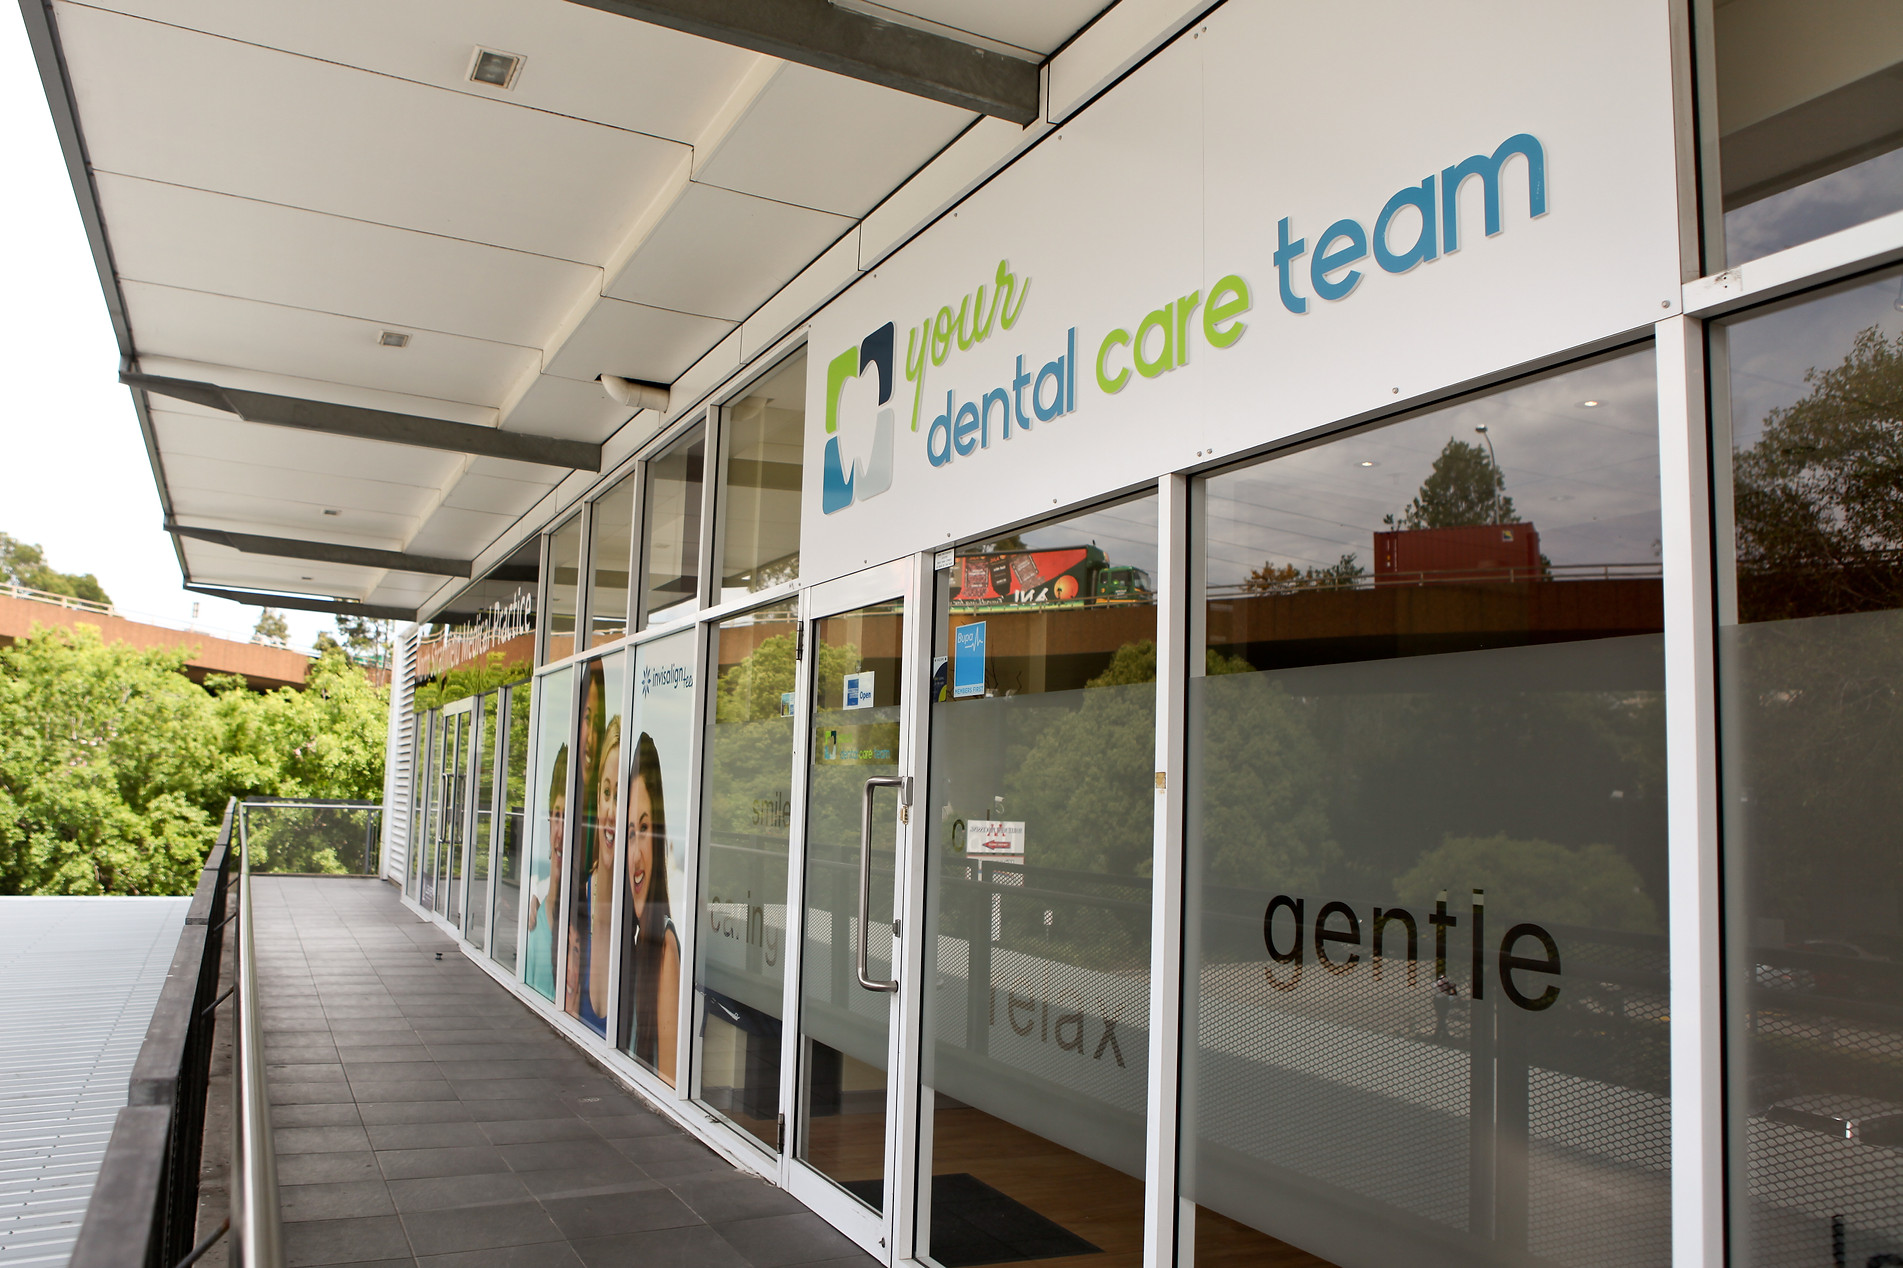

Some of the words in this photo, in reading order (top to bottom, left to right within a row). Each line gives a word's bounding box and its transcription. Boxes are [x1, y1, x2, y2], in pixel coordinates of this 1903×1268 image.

[927, 327, 1076, 467] dental
[1096, 275, 1250, 393] care
[1273, 133, 1547, 314] team
[904, 259, 1031, 431] your
[492, 587, 532, 647] Practice
[957, 632, 974, 645] Bupa
[652, 663, 684, 689] invisalign
[683, 667, 694, 688] tee
[954, 687, 972, 695] MEMBERS
[973, 685, 984, 693] FIRST
[859, 691, 872, 701] Open
[859, 749, 873, 760] care
[751, 791, 791, 828] smile
[709, 890, 779, 967] caing
[1263, 888, 1562, 1012] gentle
